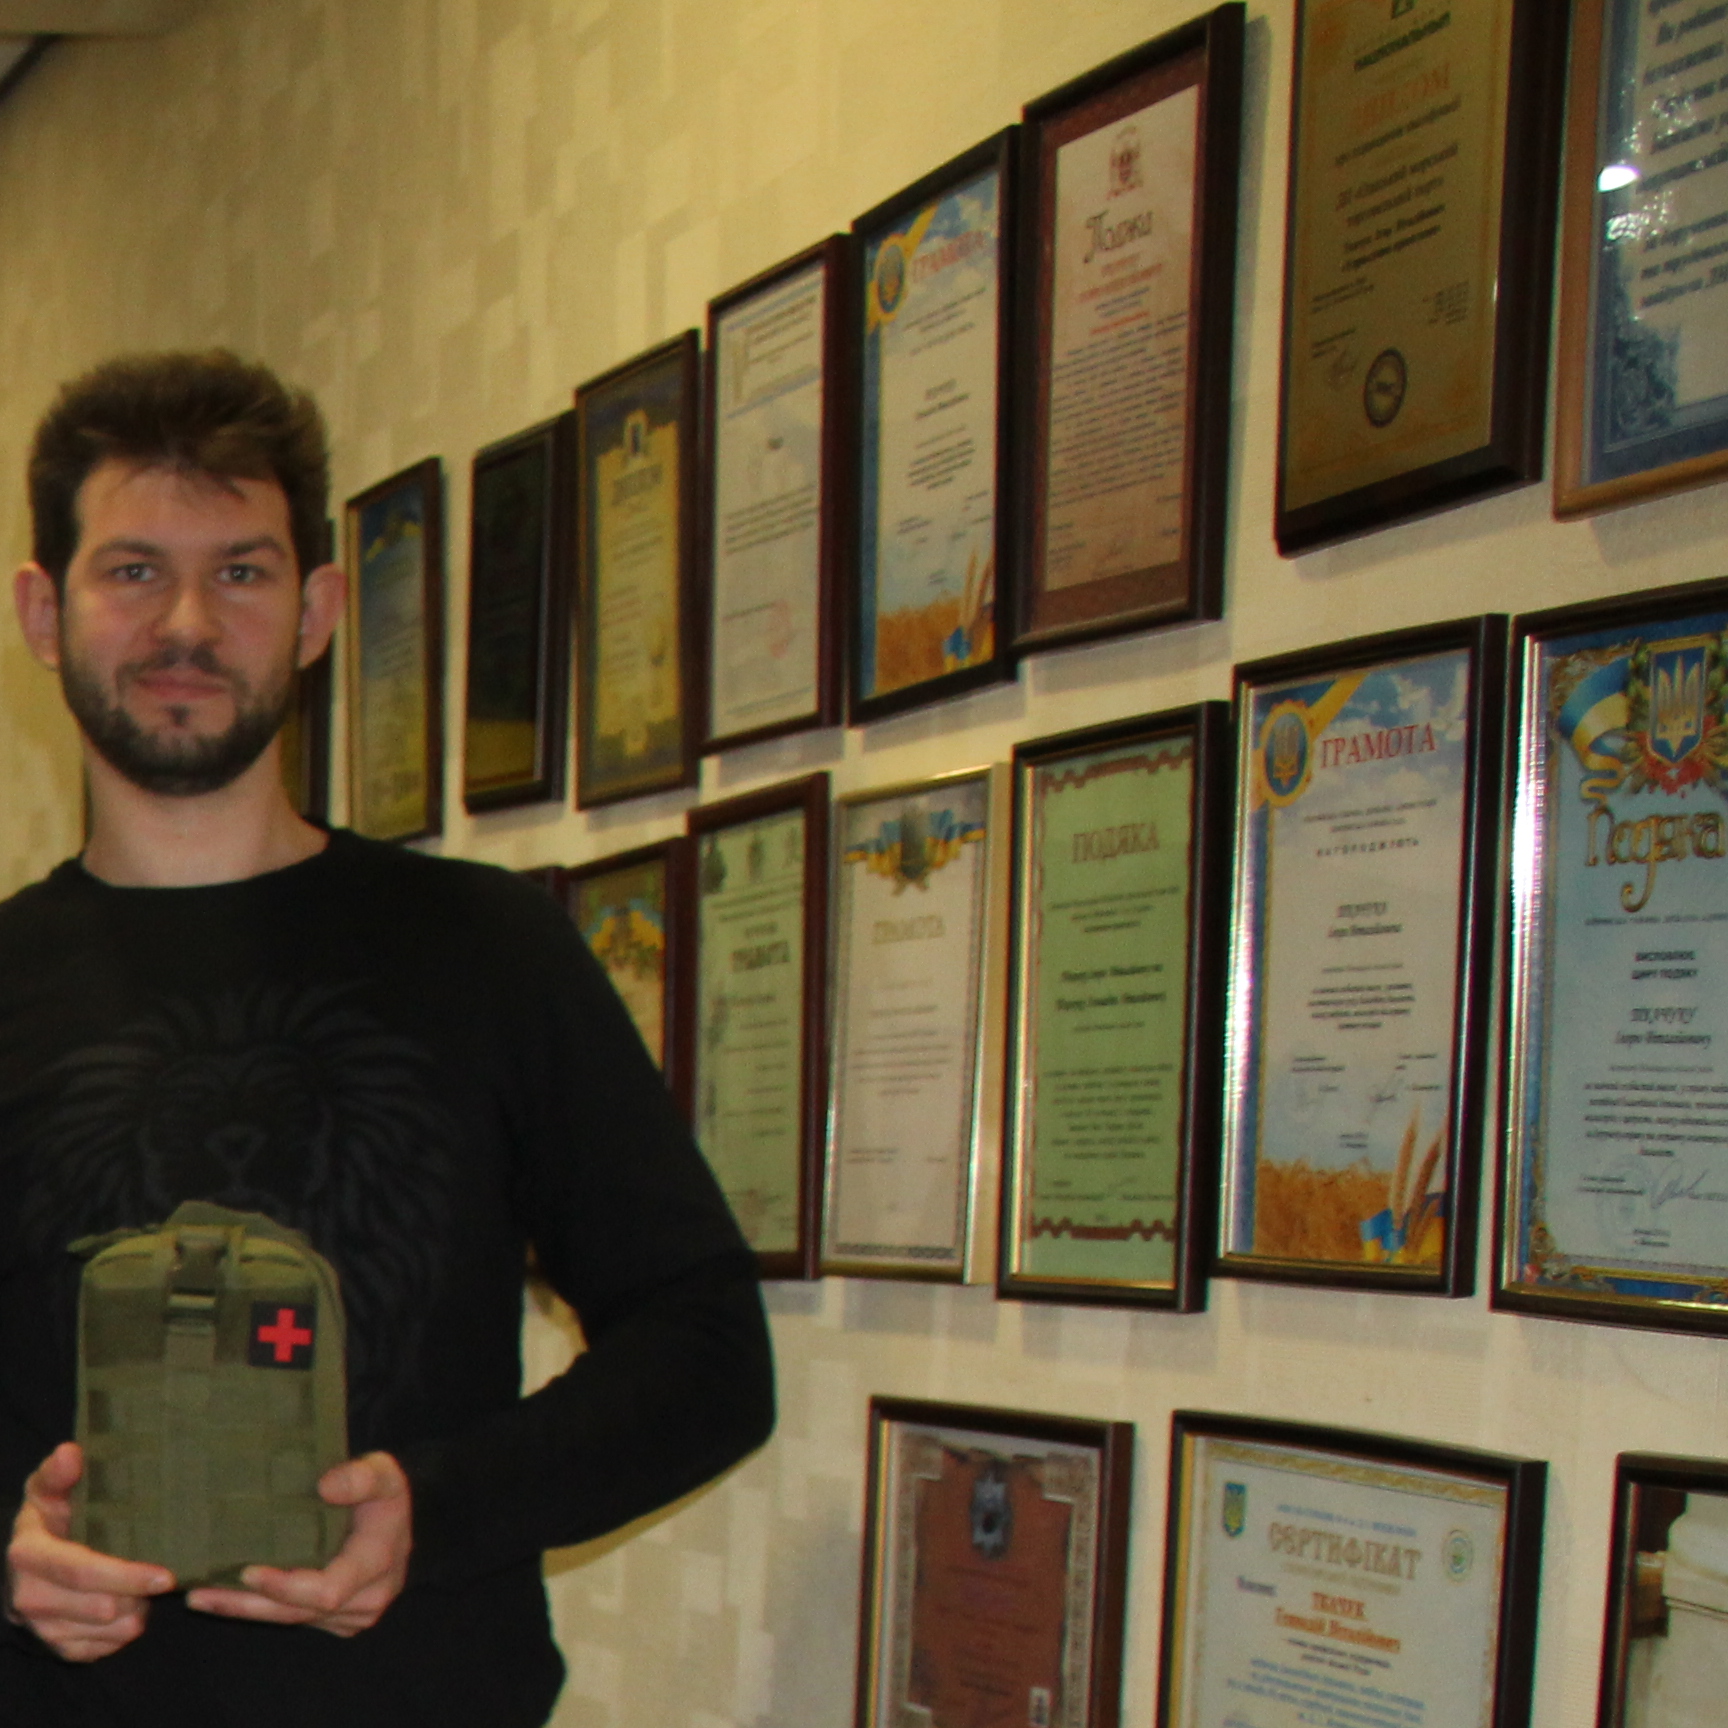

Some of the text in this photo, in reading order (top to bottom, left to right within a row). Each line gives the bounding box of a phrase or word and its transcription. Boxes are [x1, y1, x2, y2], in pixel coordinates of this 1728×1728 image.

[1320, 723, 1437, 768] ГРАМОТА
[1072, 821, 1161, 864] ПОДЯКА
[1584, 806, 1727, 913] Подяка
